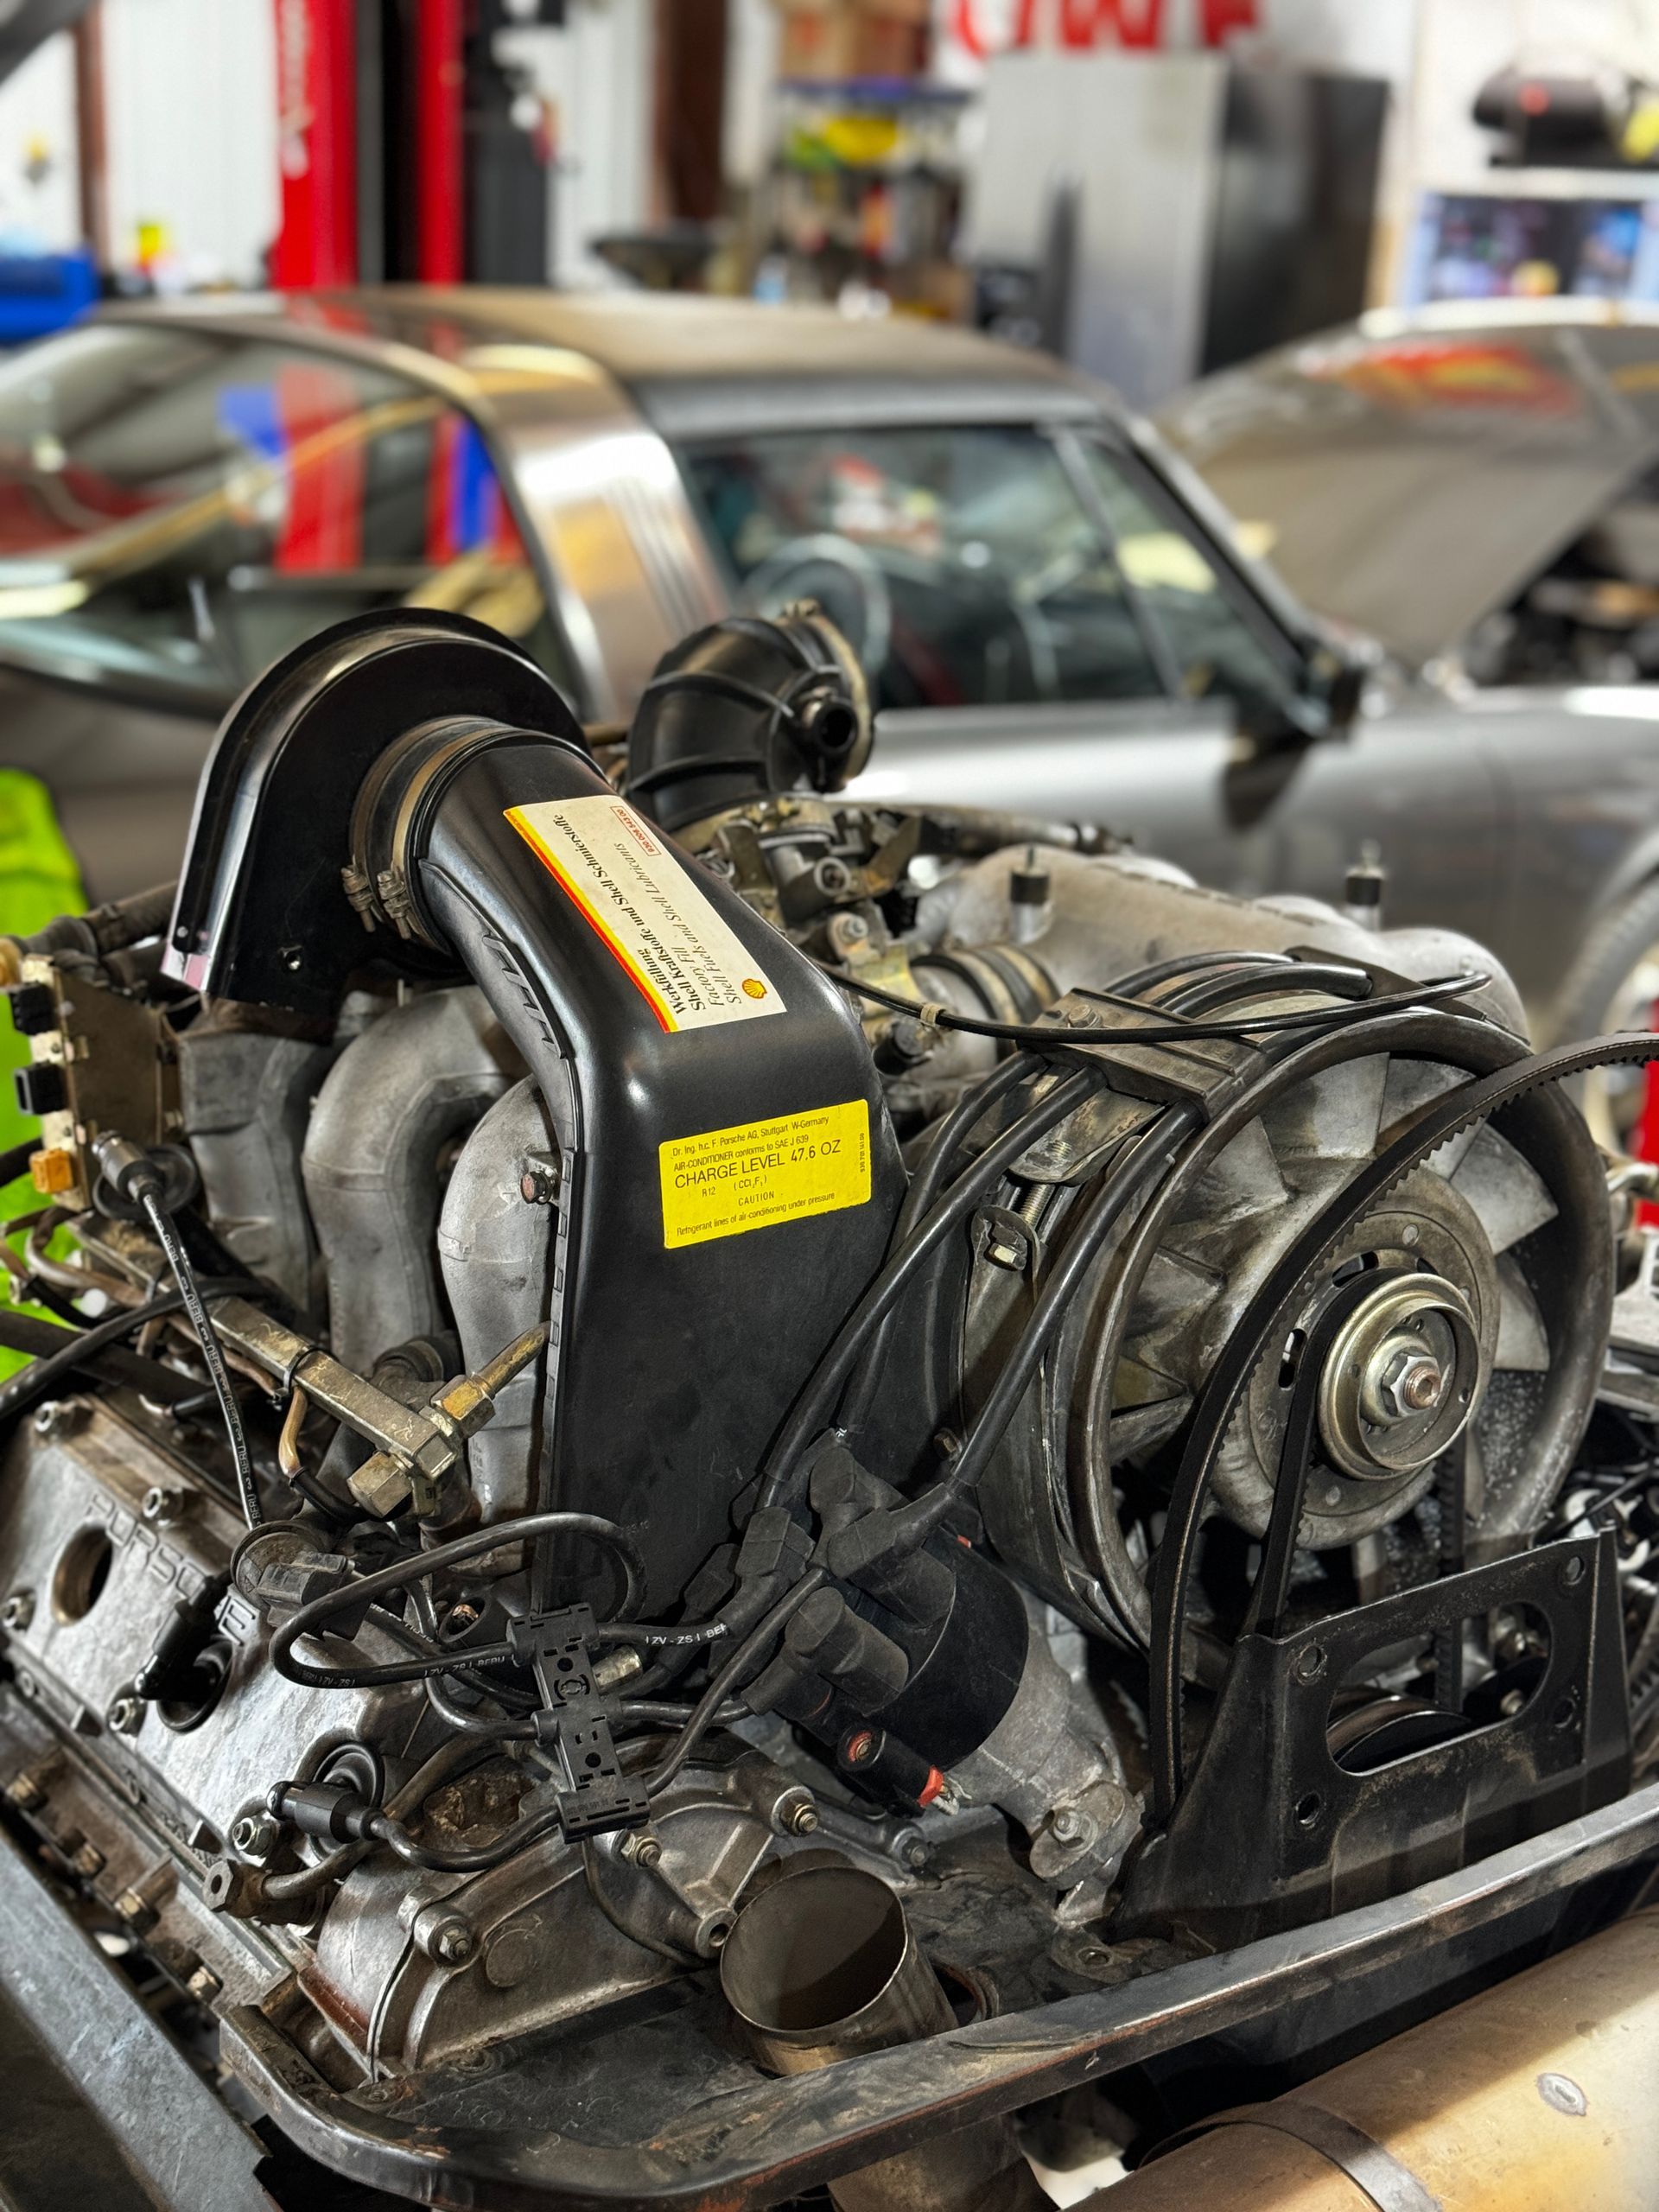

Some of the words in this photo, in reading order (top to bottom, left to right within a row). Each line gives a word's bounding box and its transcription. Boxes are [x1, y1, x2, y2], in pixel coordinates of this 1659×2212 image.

[553, 815, 607, 878] Schmierstoffe
[614, 843, 660, 893] Lubricants
[601, 880, 628, 905] Shell
[621, 907, 645, 925] und
[652, 897, 681, 920] Shell
[673, 925, 698, 942] and
[640, 929, 685, 979] Kraftstoffe
[671, 948, 695, 963] Fill
[692, 946, 721, 971] Fuels
[638, 949, 685, 1014] Werkfüllung
[677, 982, 706, 1010] Shell
[690, 967, 724, 1005] Factory
[712, 976, 741, 1003] Shell
[673, 1147, 683, 1156] Dr.
[720, 1135, 745, 1146] Porsche
[747, 1130, 759, 1140] AG,
[760, 1124, 788, 1137] Stuttgart
[791, 1116, 829, 1129] W-Germany
[674, 1151, 733, 1172] AIR-CONDITIONER
[735, 1146, 765, 1157] conforms
[775, 1138, 788, 1148] SAE
[790, 1137, 794, 1146] J
[796, 1135, 808, 1144] 639
[675, 1162, 738, 1188] CHARGE
[742, 1153, 785, 1173] LEVEL
[821, 1139, 841, 1155] OZ
[739, 1191, 774, 1206] CAUTION
[677, 1221, 712, 1236] Refrigerant
[714, 1218, 728, 1227] lines
[730, 1214, 736, 1223] of
[739, 1205, 786, 1221] air-conditioning
[788, 1199, 805, 1209] under
[808, 1192, 835, 1205] pressure
[186, 1294, 204, 1325] BERU
[206, 1344, 222, 1376] BERU
[224, 1395, 239, 1425] BERU
[238, 1445, 251, 1475] BERU
[247, 1494, 262, 1520] BERU
[85, 1492, 257, 1647] PORSCE
